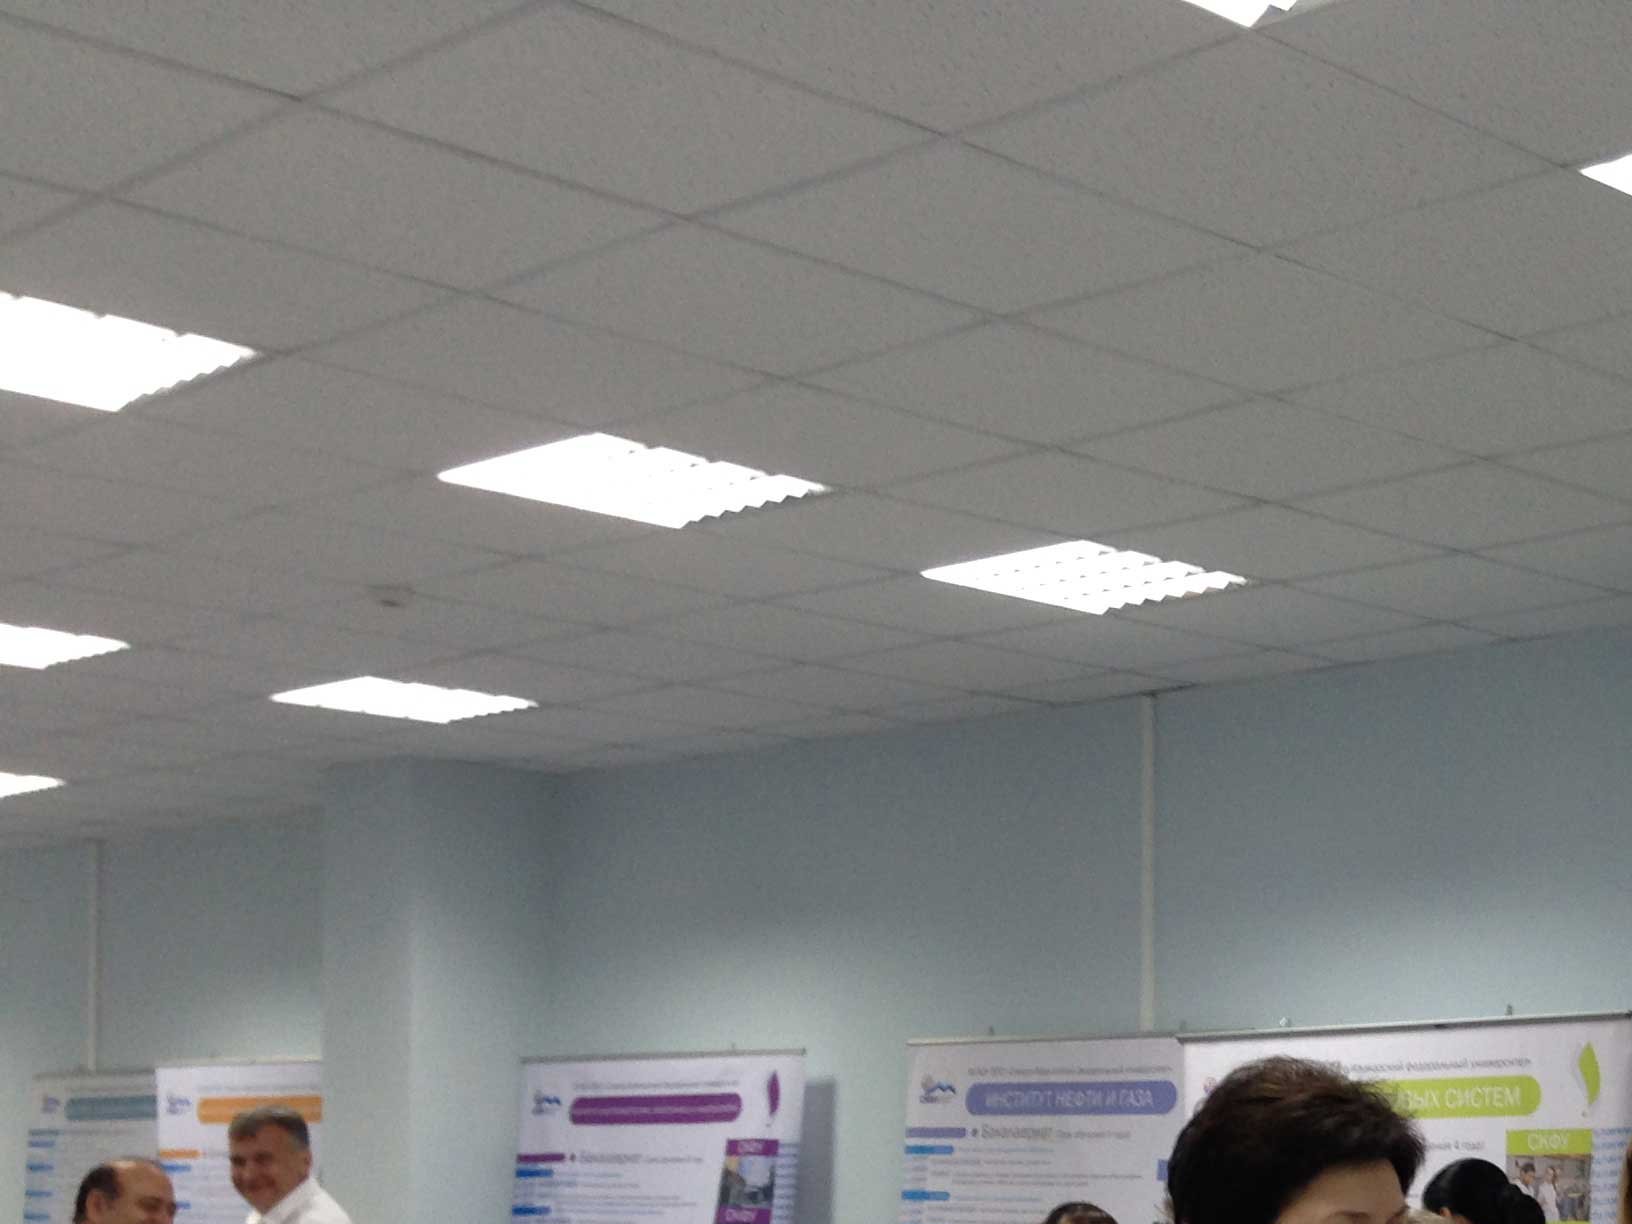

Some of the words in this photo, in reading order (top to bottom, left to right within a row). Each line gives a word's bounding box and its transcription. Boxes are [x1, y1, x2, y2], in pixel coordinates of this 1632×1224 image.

[1054, 1090, 1104, 1107] НЕФТИ
[1118, 1088, 1154, 1107] ГАЗА
[1398, 1089, 1440, 1110] ВЫХ
[1445, 1086, 1522, 1108] СИСТЕМ
[1527, 1133, 1568, 1151] СКФУ
